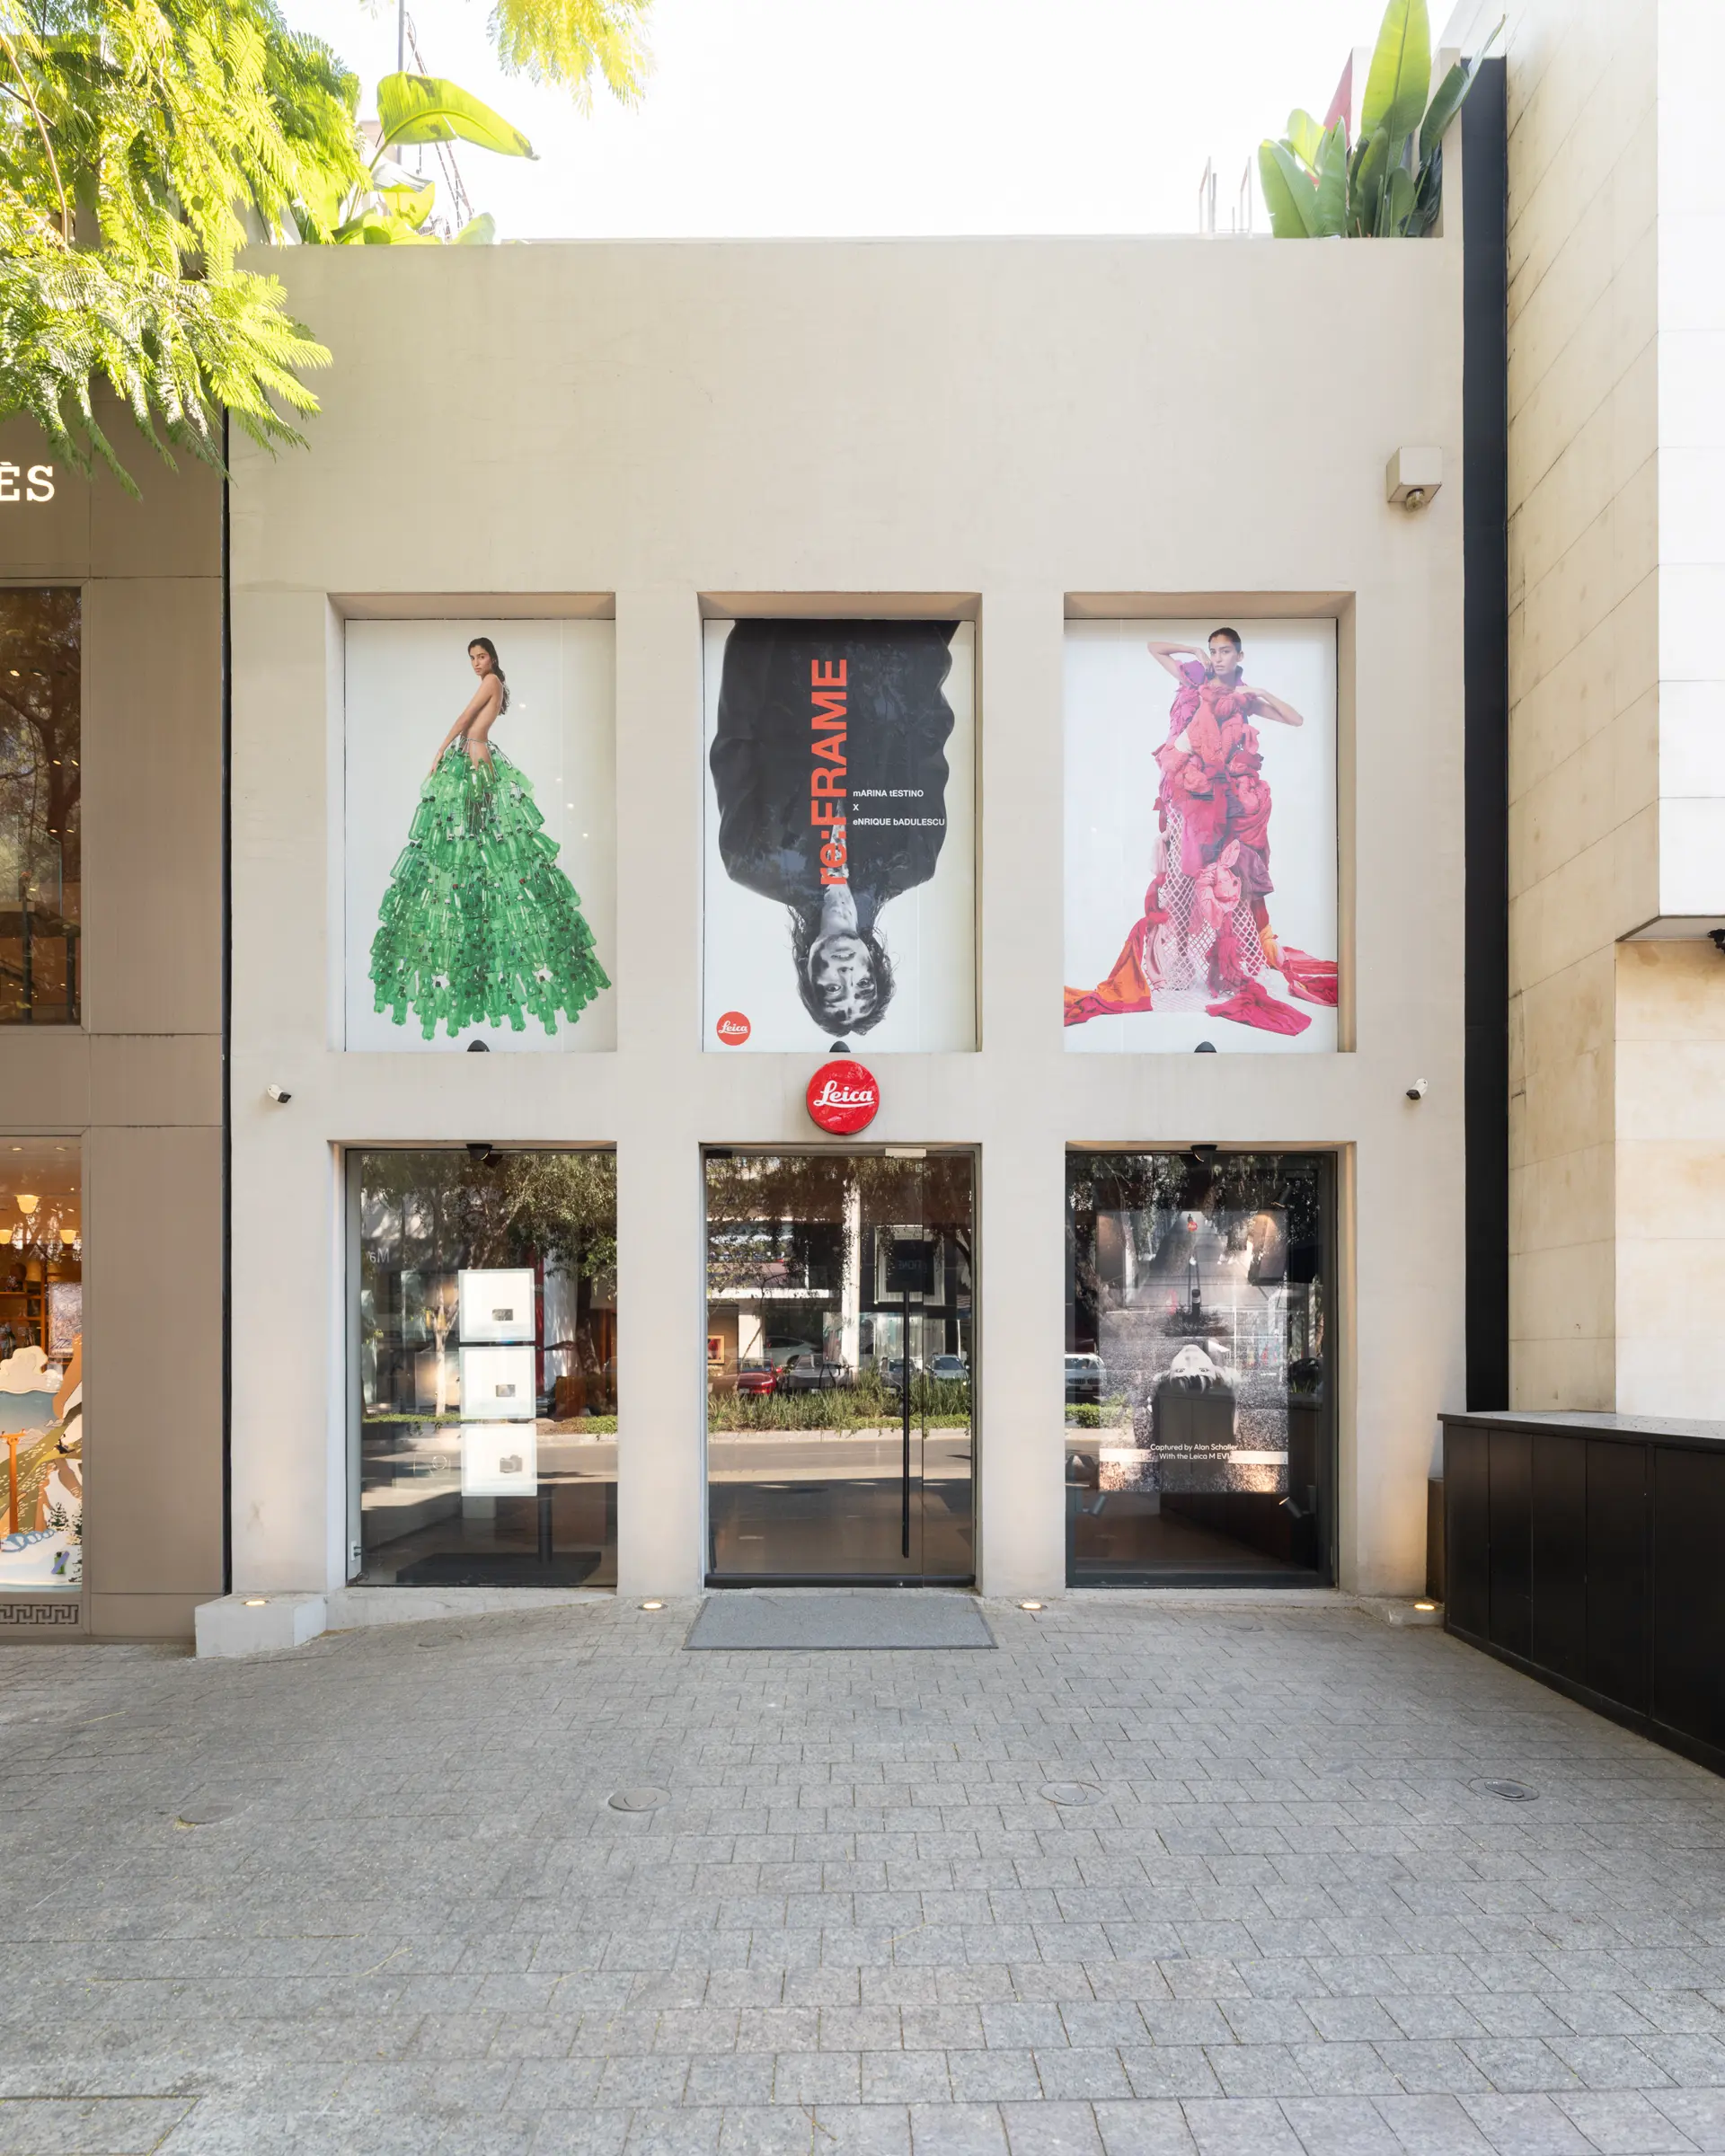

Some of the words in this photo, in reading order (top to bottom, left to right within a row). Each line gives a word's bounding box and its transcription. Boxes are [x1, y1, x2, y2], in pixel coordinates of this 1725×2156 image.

[811, 659, 847, 885] re:FRAME
[853, 790, 888, 798] mARINA
[889, 790, 924, 798] tESTINO
[718, 1021, 748, 1035] Leica
[813, 1081, 874, 1109] Leica
[1150, 1444, 1183, 1452] Captured
[1184, 1444, 1193, 1452] by
